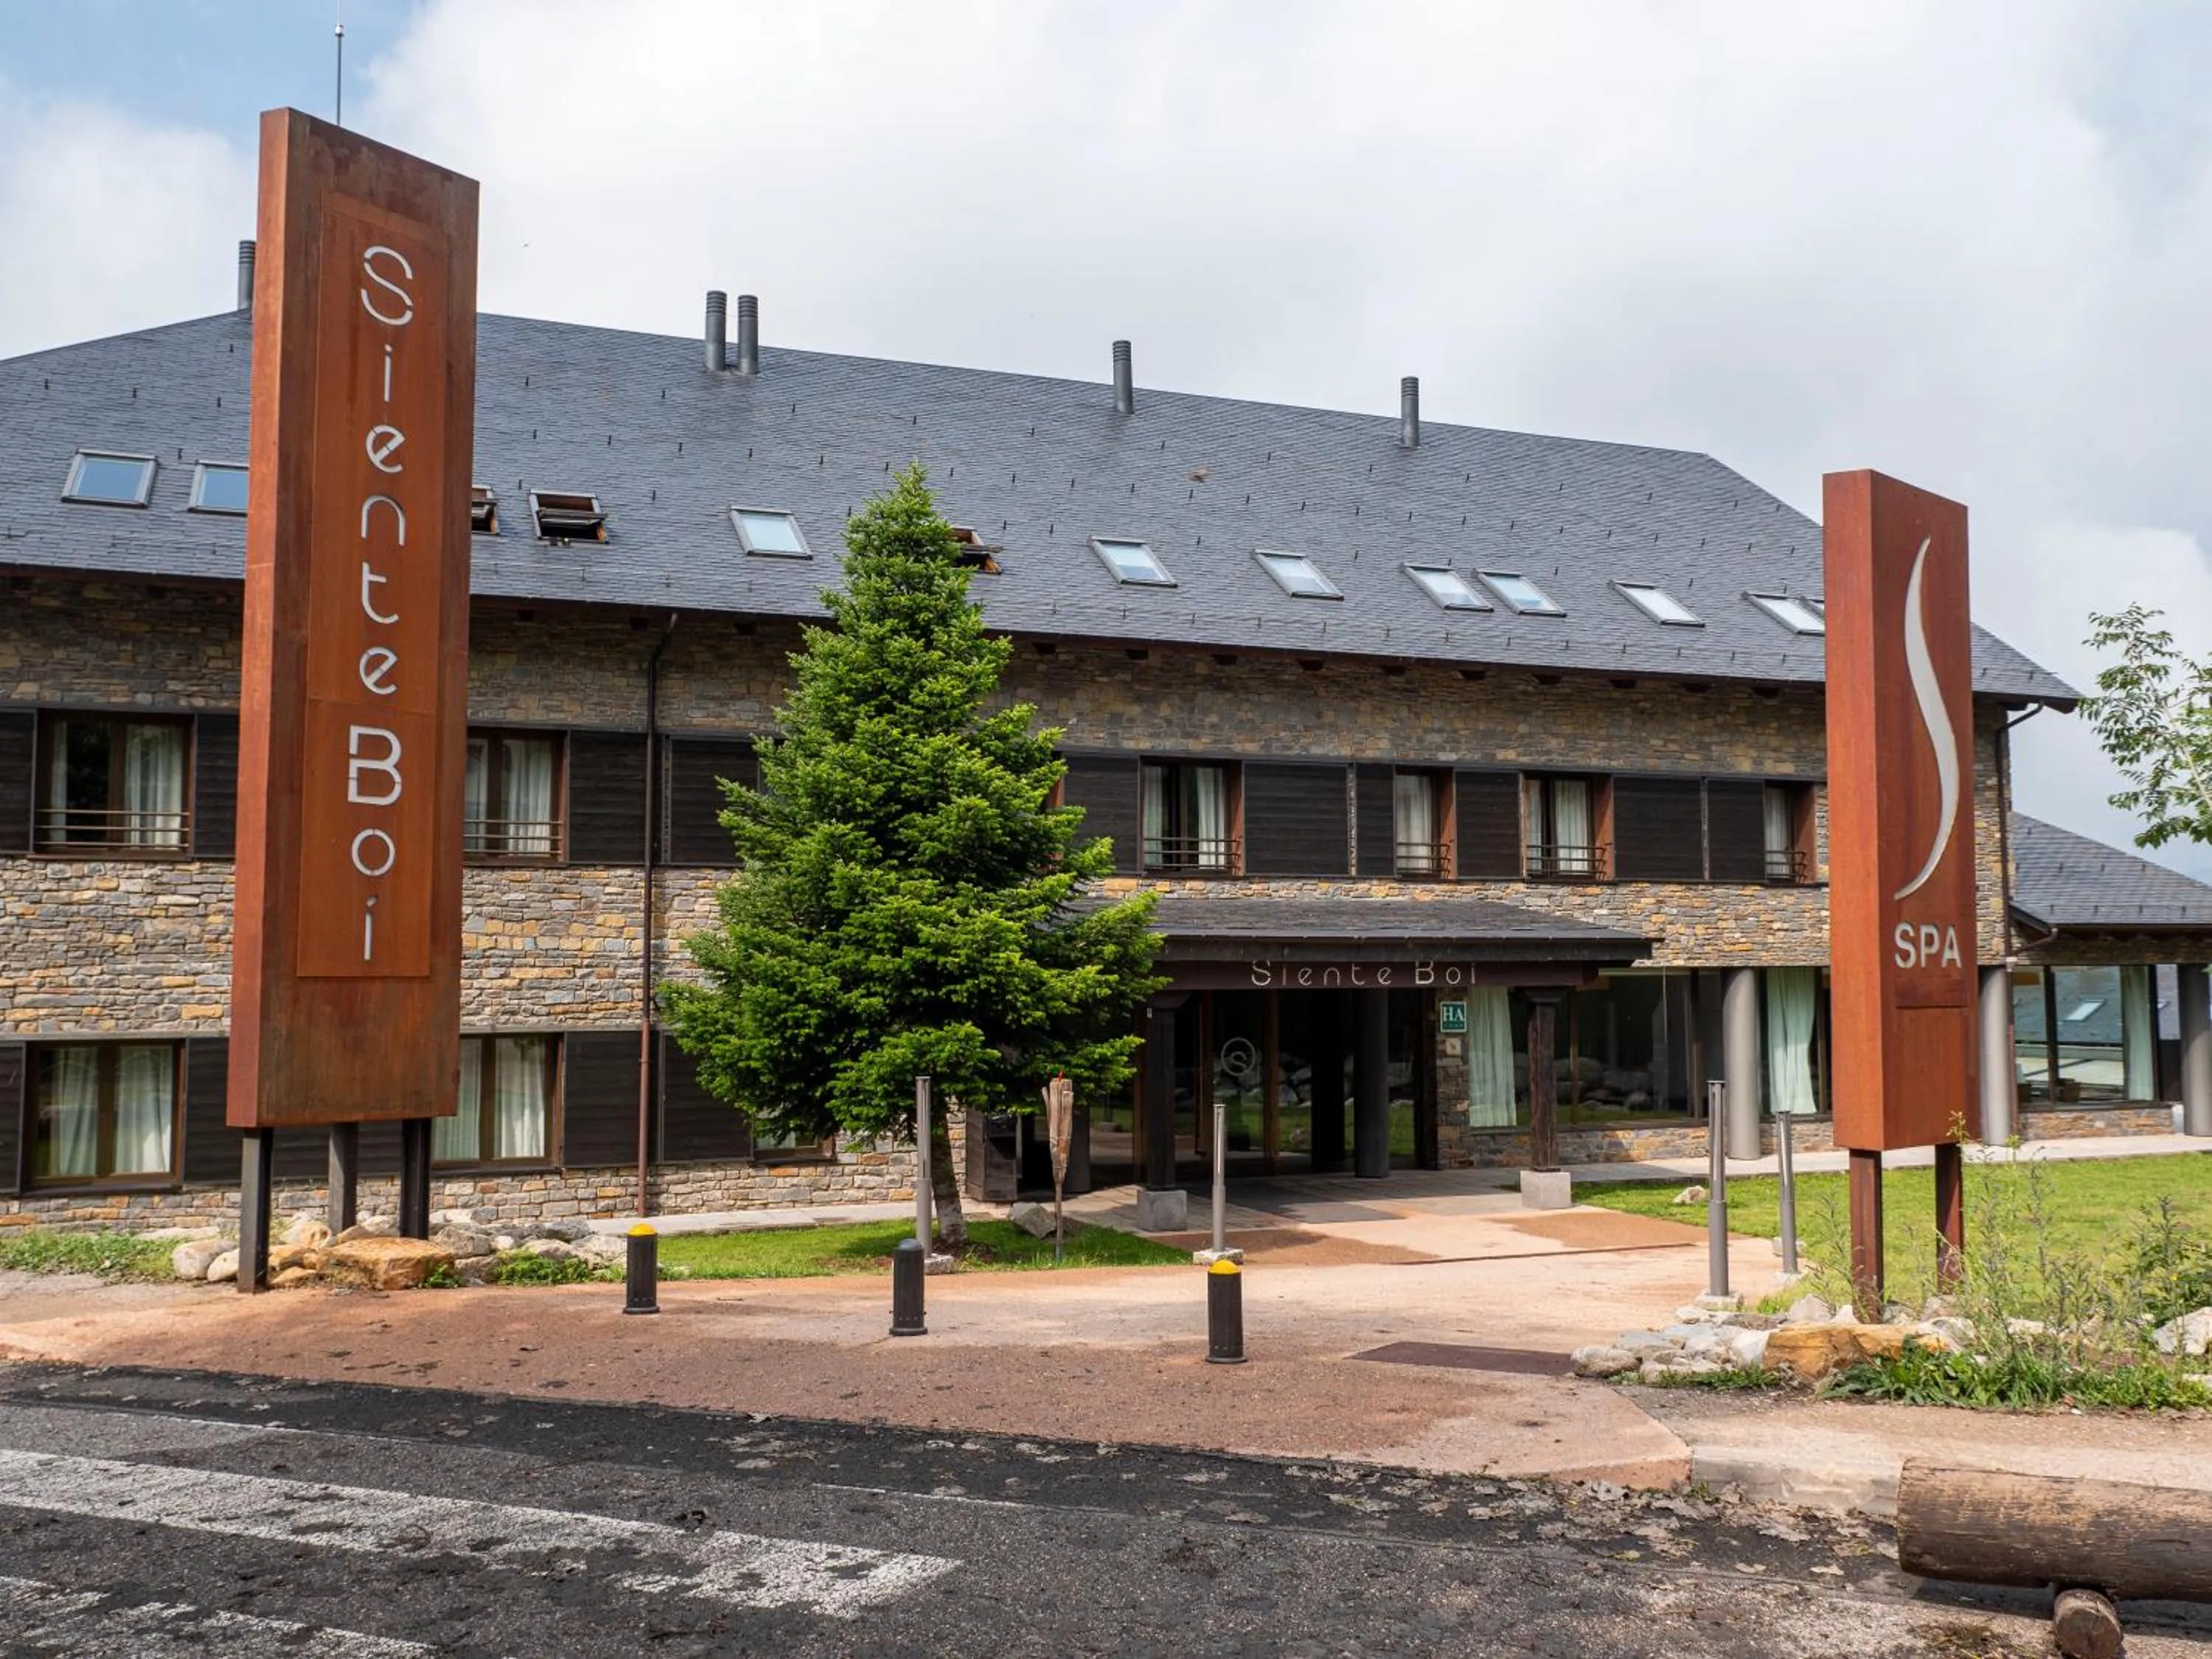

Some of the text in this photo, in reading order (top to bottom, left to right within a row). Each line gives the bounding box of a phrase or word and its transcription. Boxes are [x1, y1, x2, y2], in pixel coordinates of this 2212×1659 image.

[359, 246, 414, 695] Siente
[1894, 922, 1961, 969] SPA
[1251, 959, 1391, 986] Siente
